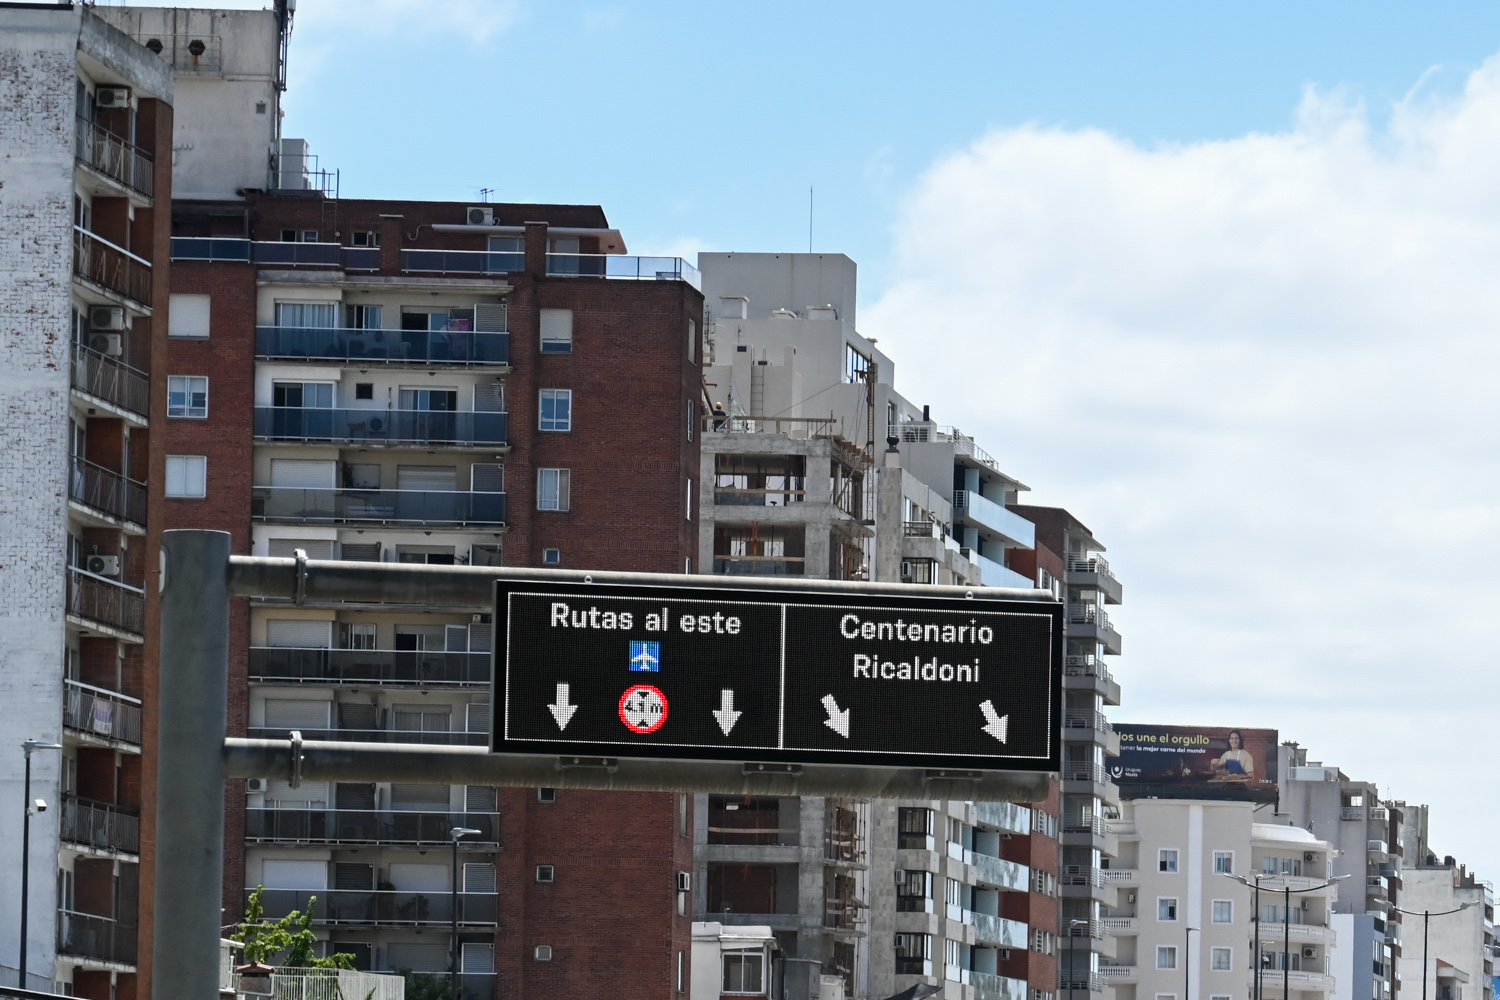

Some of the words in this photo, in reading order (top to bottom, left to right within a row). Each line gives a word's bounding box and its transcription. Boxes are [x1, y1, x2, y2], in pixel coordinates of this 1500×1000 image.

[550, 602, 633, 631] Rutas
[645, 606, 668, 632] al
[680, 610, 741, 635] este
[839, 614, 994, 645] Centenario
[853, 653, 980, 682] Ricaldoni
[1136, 733, 1157, 743] une
[1159, 732, 1169, 744] el
[1171, 733, 1210, 747] orgullo
